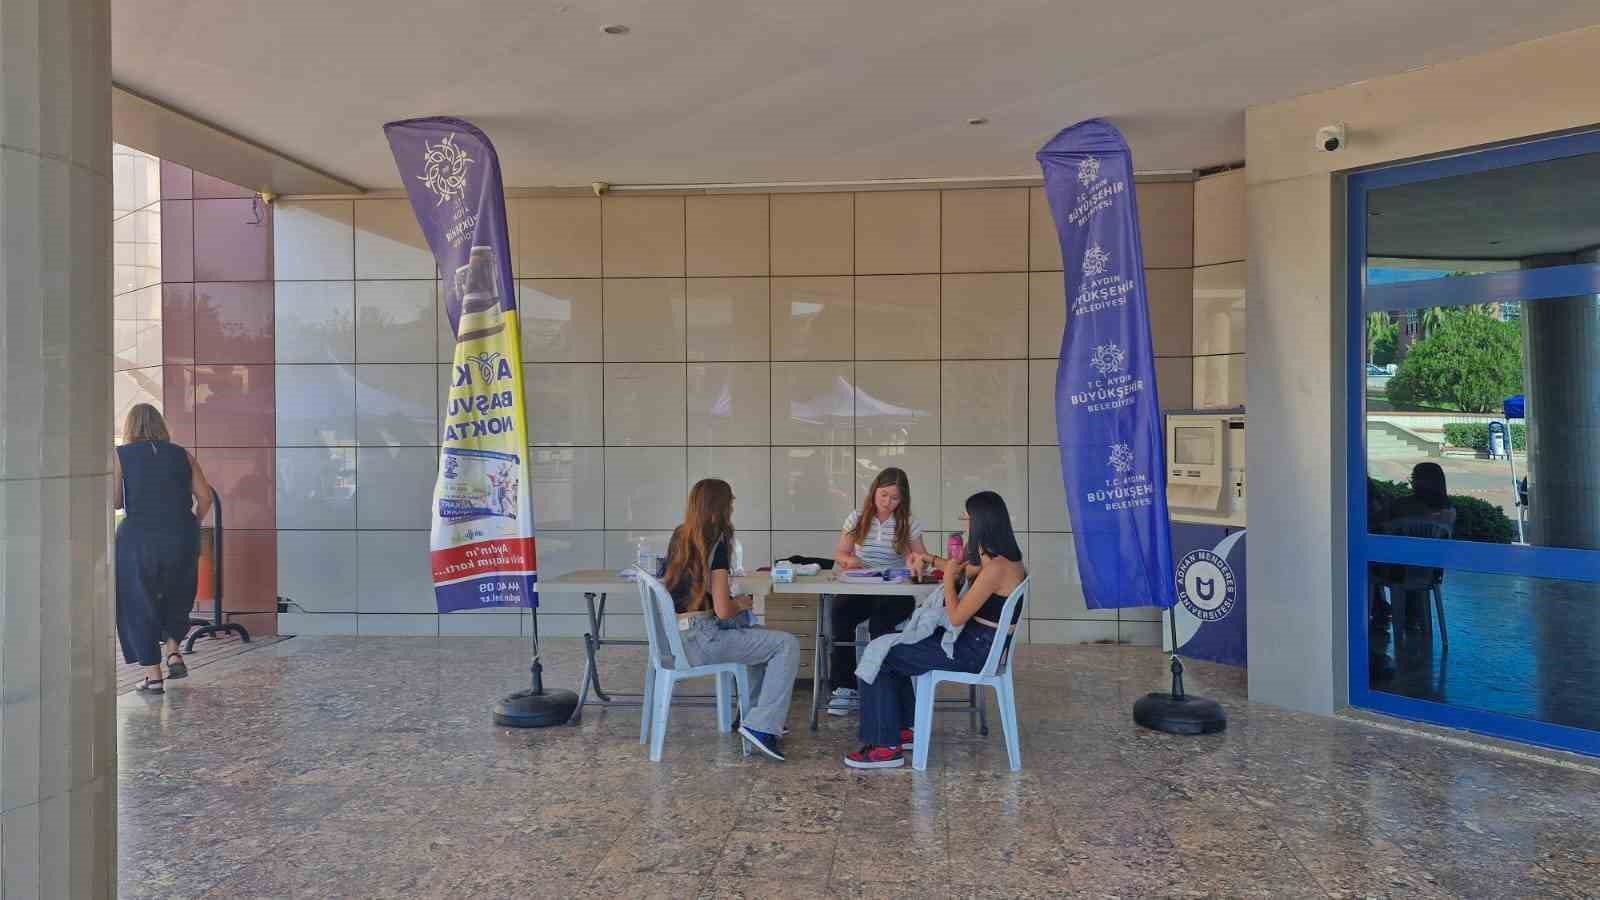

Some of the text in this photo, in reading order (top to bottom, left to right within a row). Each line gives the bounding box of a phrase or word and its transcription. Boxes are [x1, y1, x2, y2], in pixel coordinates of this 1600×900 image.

[1071, 379, 1144, 405] BÜYÜKŞEHİR
[1177, 551, 1234, 593] ADNAN MENDERES
